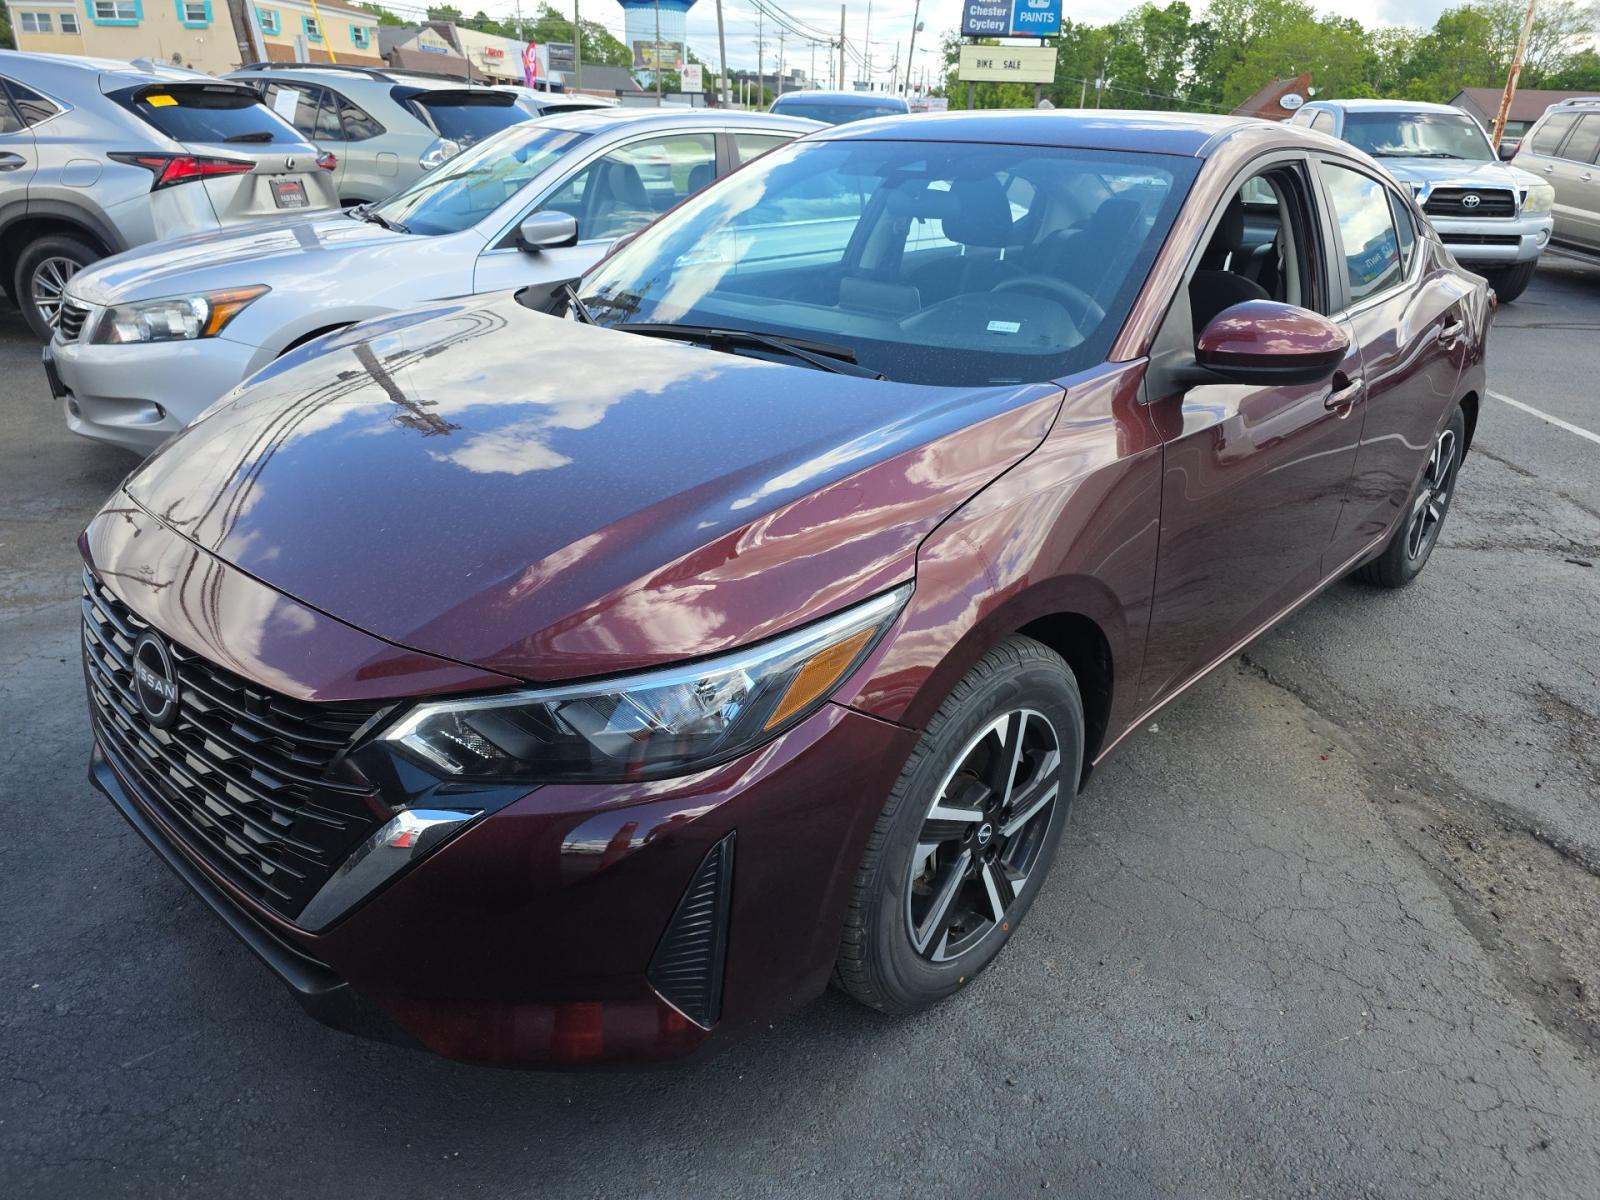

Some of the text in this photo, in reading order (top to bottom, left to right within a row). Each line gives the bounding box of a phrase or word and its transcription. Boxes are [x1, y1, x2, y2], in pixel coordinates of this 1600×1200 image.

[970, 5, 1007, 16] Chester
[1020, 12, 1055, 23] PAINTS
[969, 18, 1005, 31] Cyclery
[976, 59, 1021, 70] BIKE SALE
